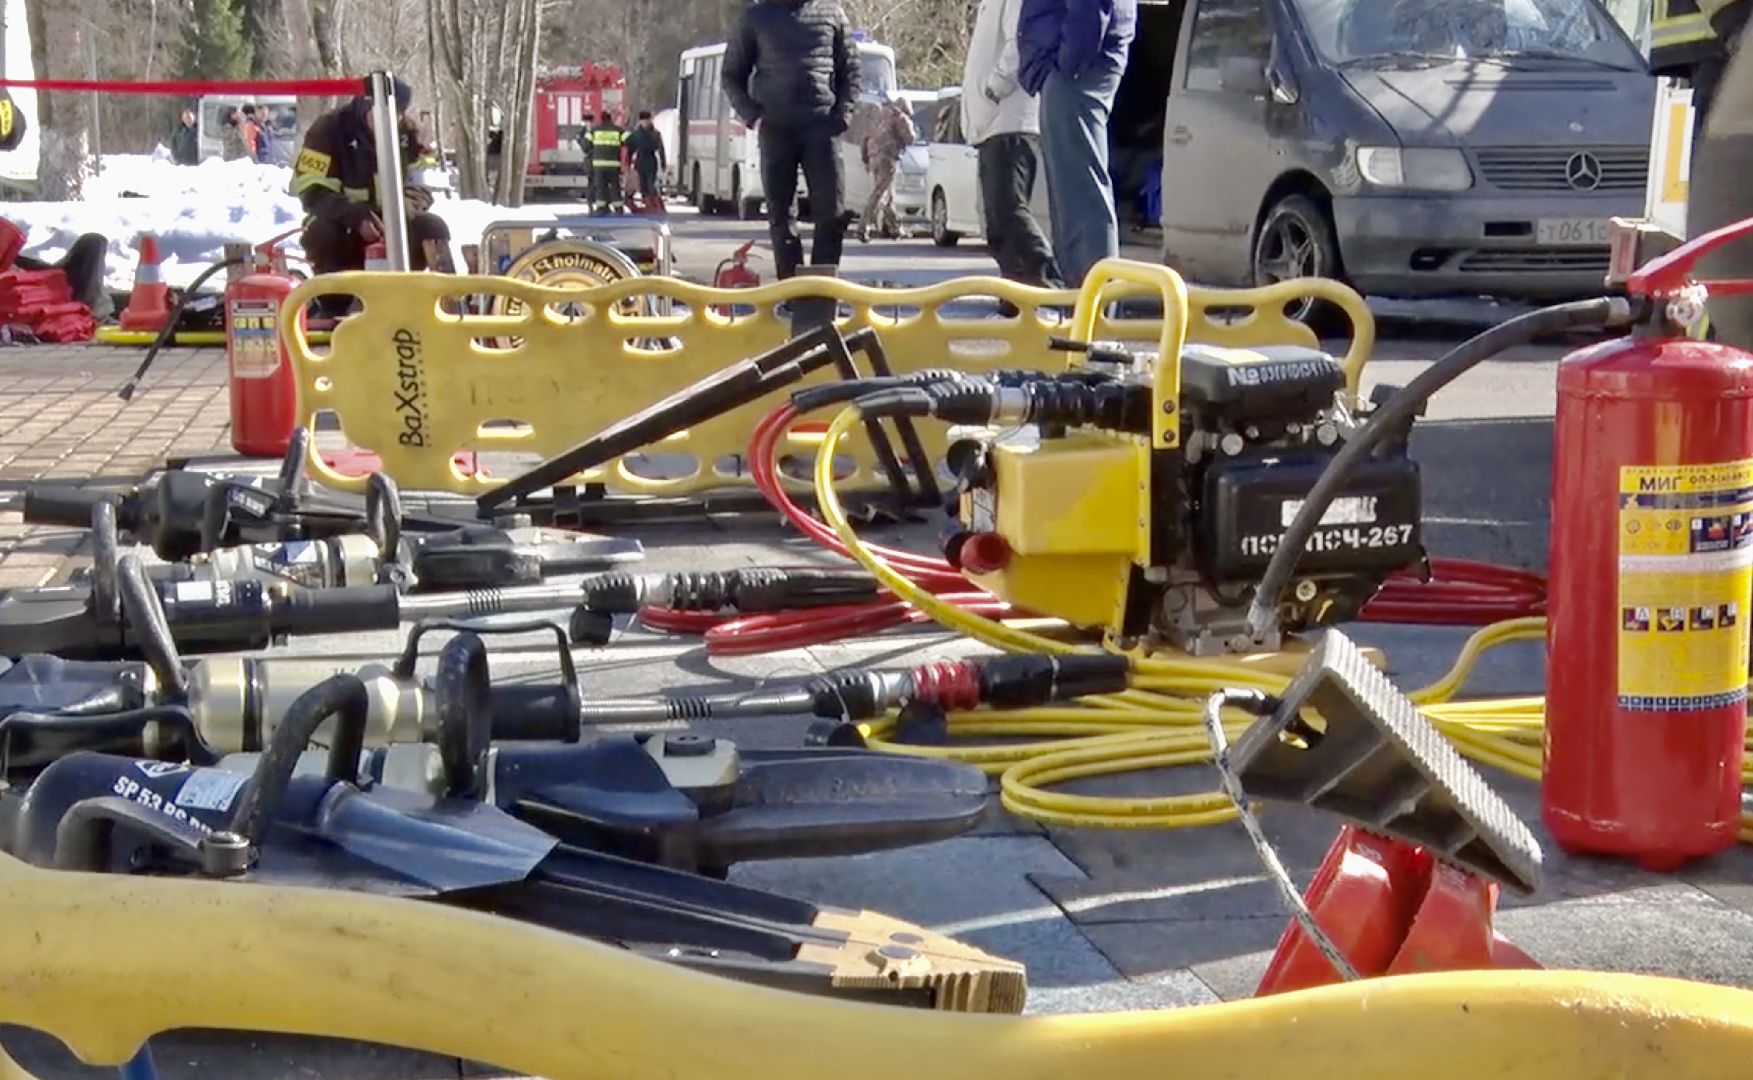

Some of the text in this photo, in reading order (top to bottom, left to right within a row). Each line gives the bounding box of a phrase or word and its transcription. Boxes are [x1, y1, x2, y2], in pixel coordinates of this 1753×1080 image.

[392, 328, 424, 447] BaXstrap
[1640, 477, 1683, 491] МИГ
[113, 775, 139, 798] SP
